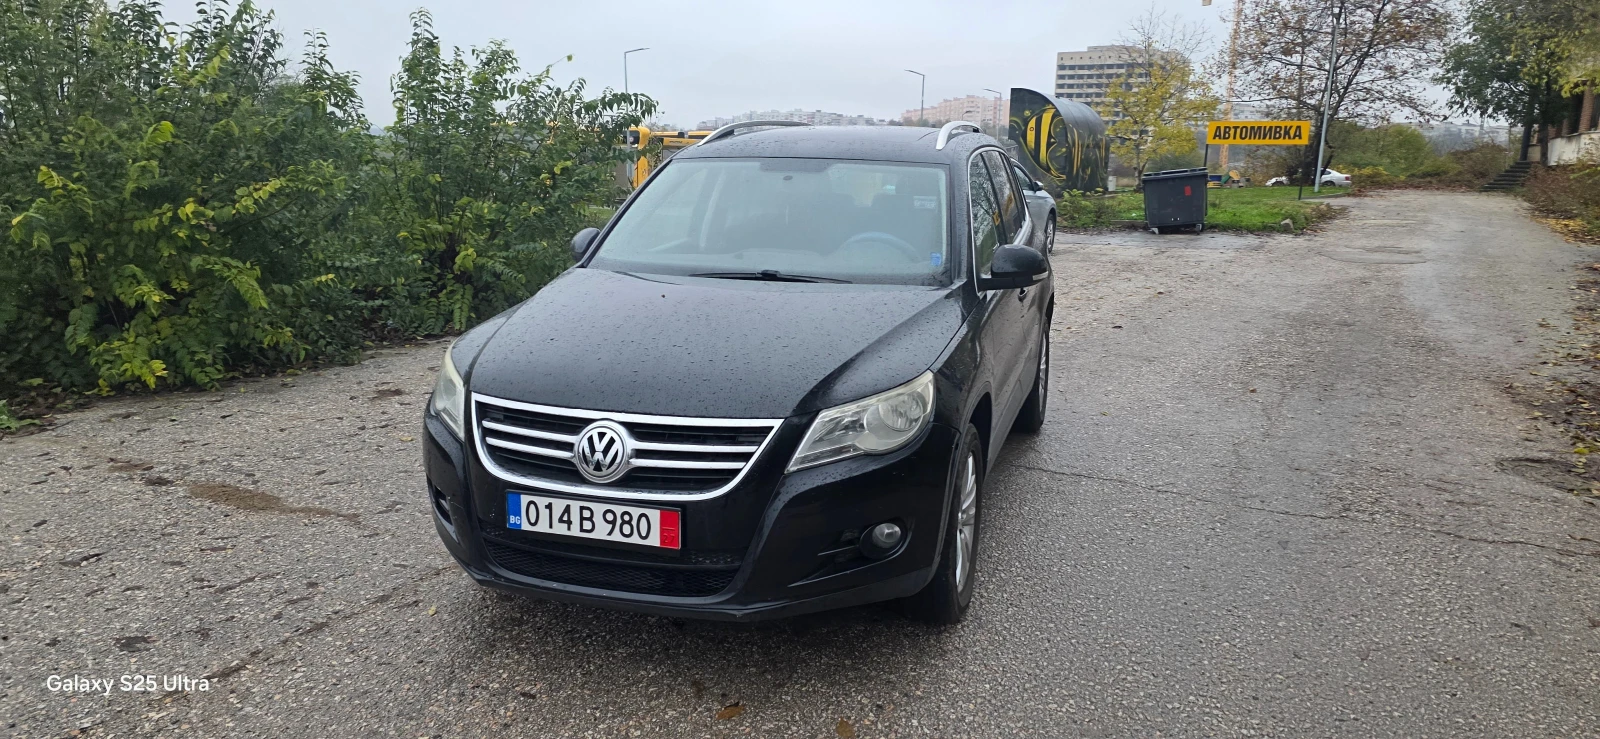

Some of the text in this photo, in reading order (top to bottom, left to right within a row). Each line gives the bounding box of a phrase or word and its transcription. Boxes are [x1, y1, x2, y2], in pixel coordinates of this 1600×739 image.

[1213, 125, 1303, 140] АВТОМИВКА
[580, 428, 621, 474] VW
[509, 515, 521, 525] BG
